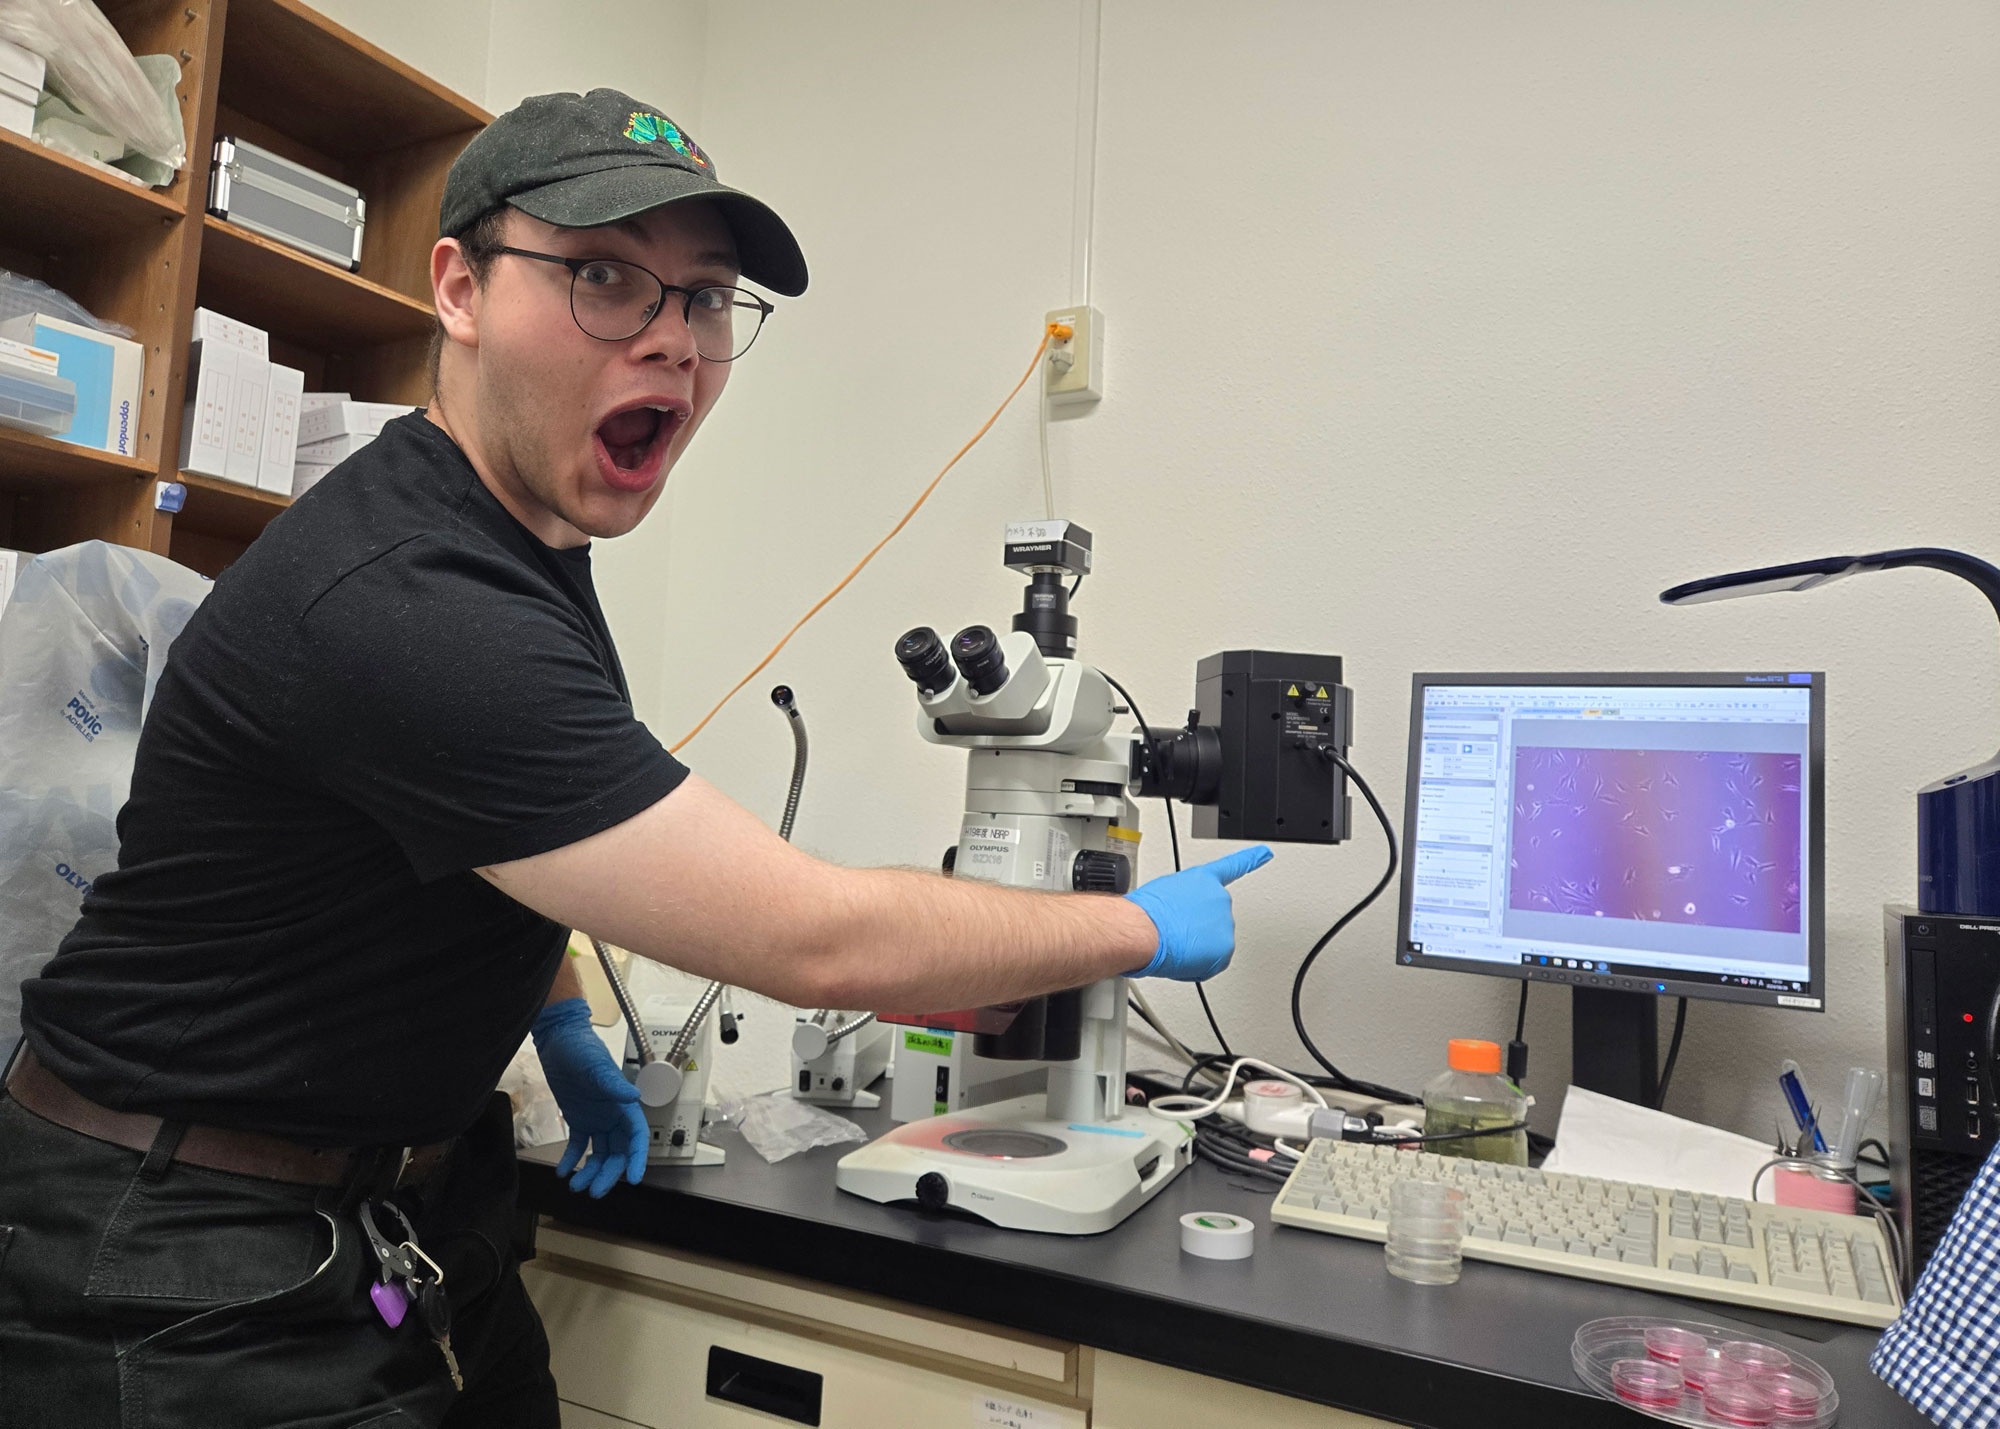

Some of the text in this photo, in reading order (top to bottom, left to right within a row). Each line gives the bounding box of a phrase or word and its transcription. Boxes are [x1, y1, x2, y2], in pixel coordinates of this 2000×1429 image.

[118, 400, 130, 456] eppendorf
[1013, 544, 1052, 553] WRAYMER
[65, 714, 95, 743] ACHILLES
[969, 844, 1010, 853] OLYMPUS
